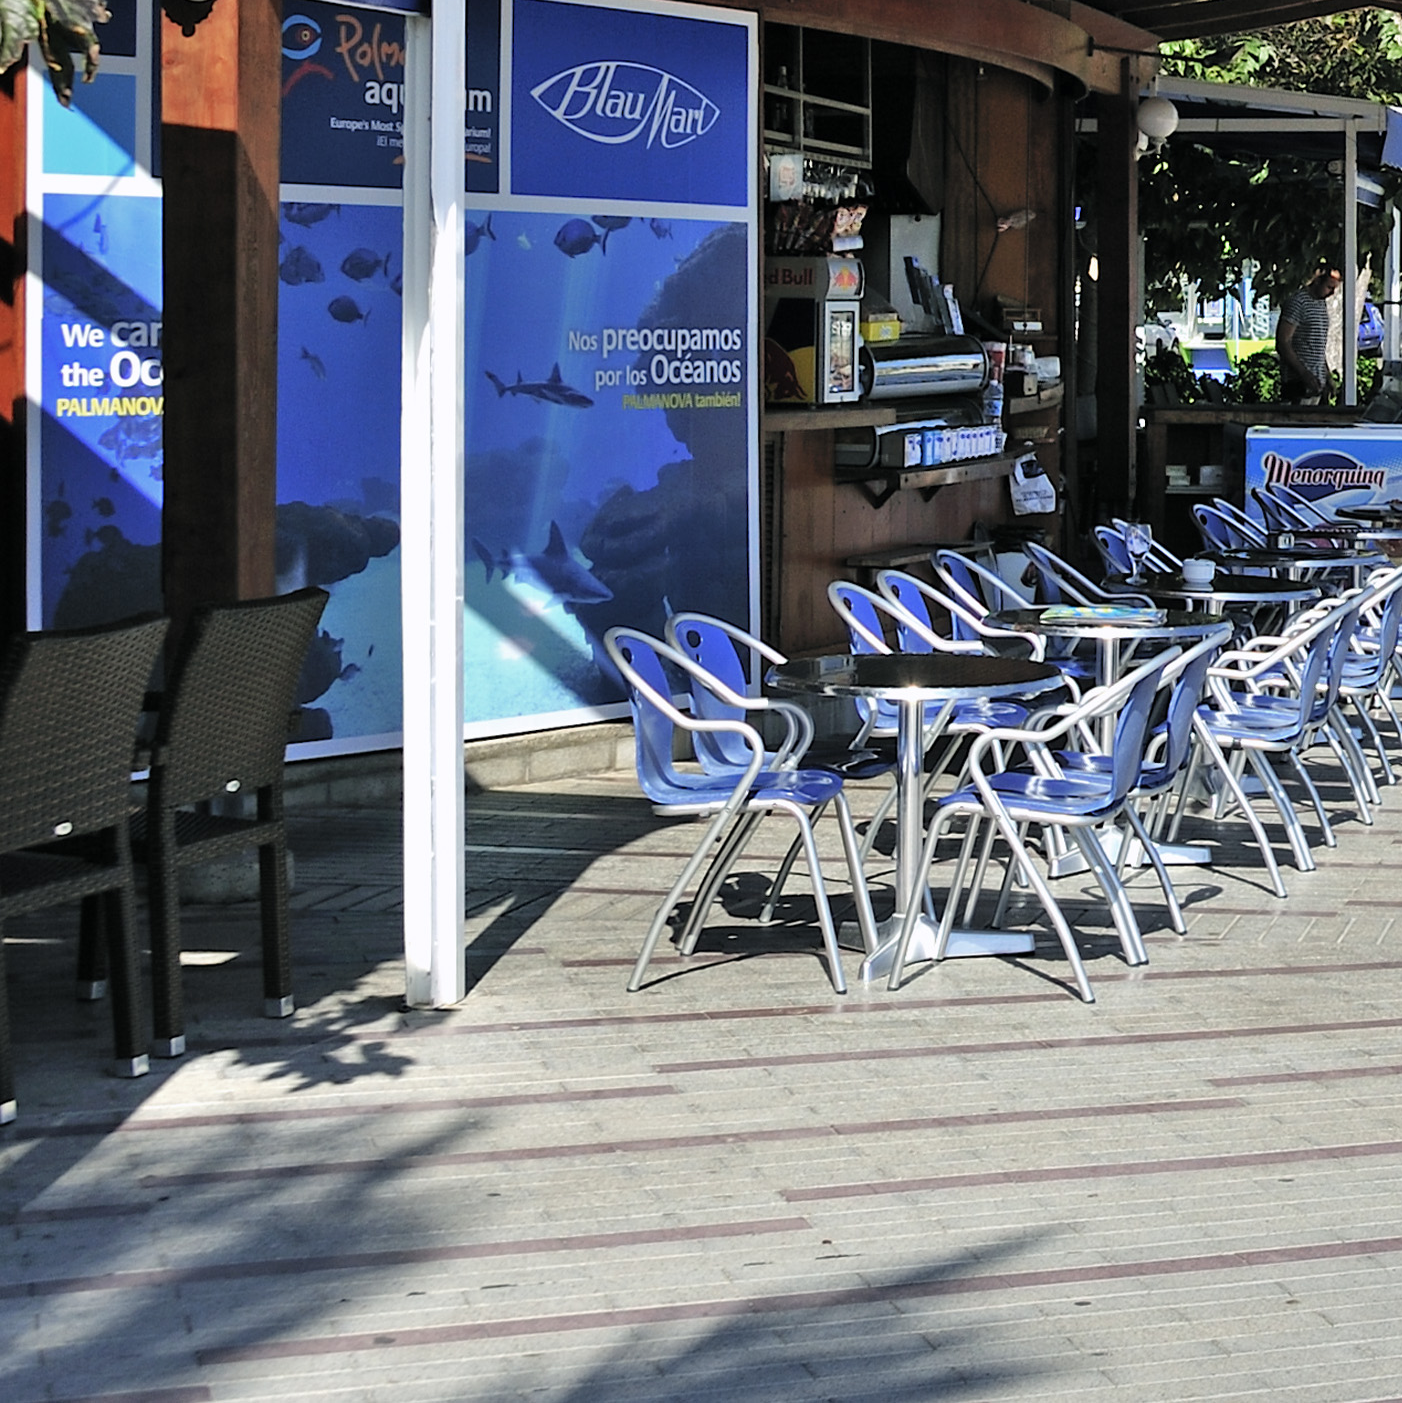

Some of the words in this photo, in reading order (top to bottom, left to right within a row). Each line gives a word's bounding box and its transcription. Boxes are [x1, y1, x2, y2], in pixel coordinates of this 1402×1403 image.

[553, 64, 646, 120] Blau
[330, 117, 369, 132] Europe's
[371, 121, 395, 133] Most
[465, 142, 491, 154] uropa!
[782, 268, 813, 285] Bull
[61, 323, 104, 348] We
[110, 321, 162, 348] car
[569, 330, 598, 351] Nos
[603, 328, 741, 358] preocupamos
[61, 361, 104, 387] the
[595, 369, 622, 391] por
[626, 365, 647, 386] los
[651, 352, 741, 385] Océanos
[56, 397, 164, 417] PALMANOV
[622, 393, 693, 410] PALMANOVA
[1264, 454, 1386, 491] Menorquina
